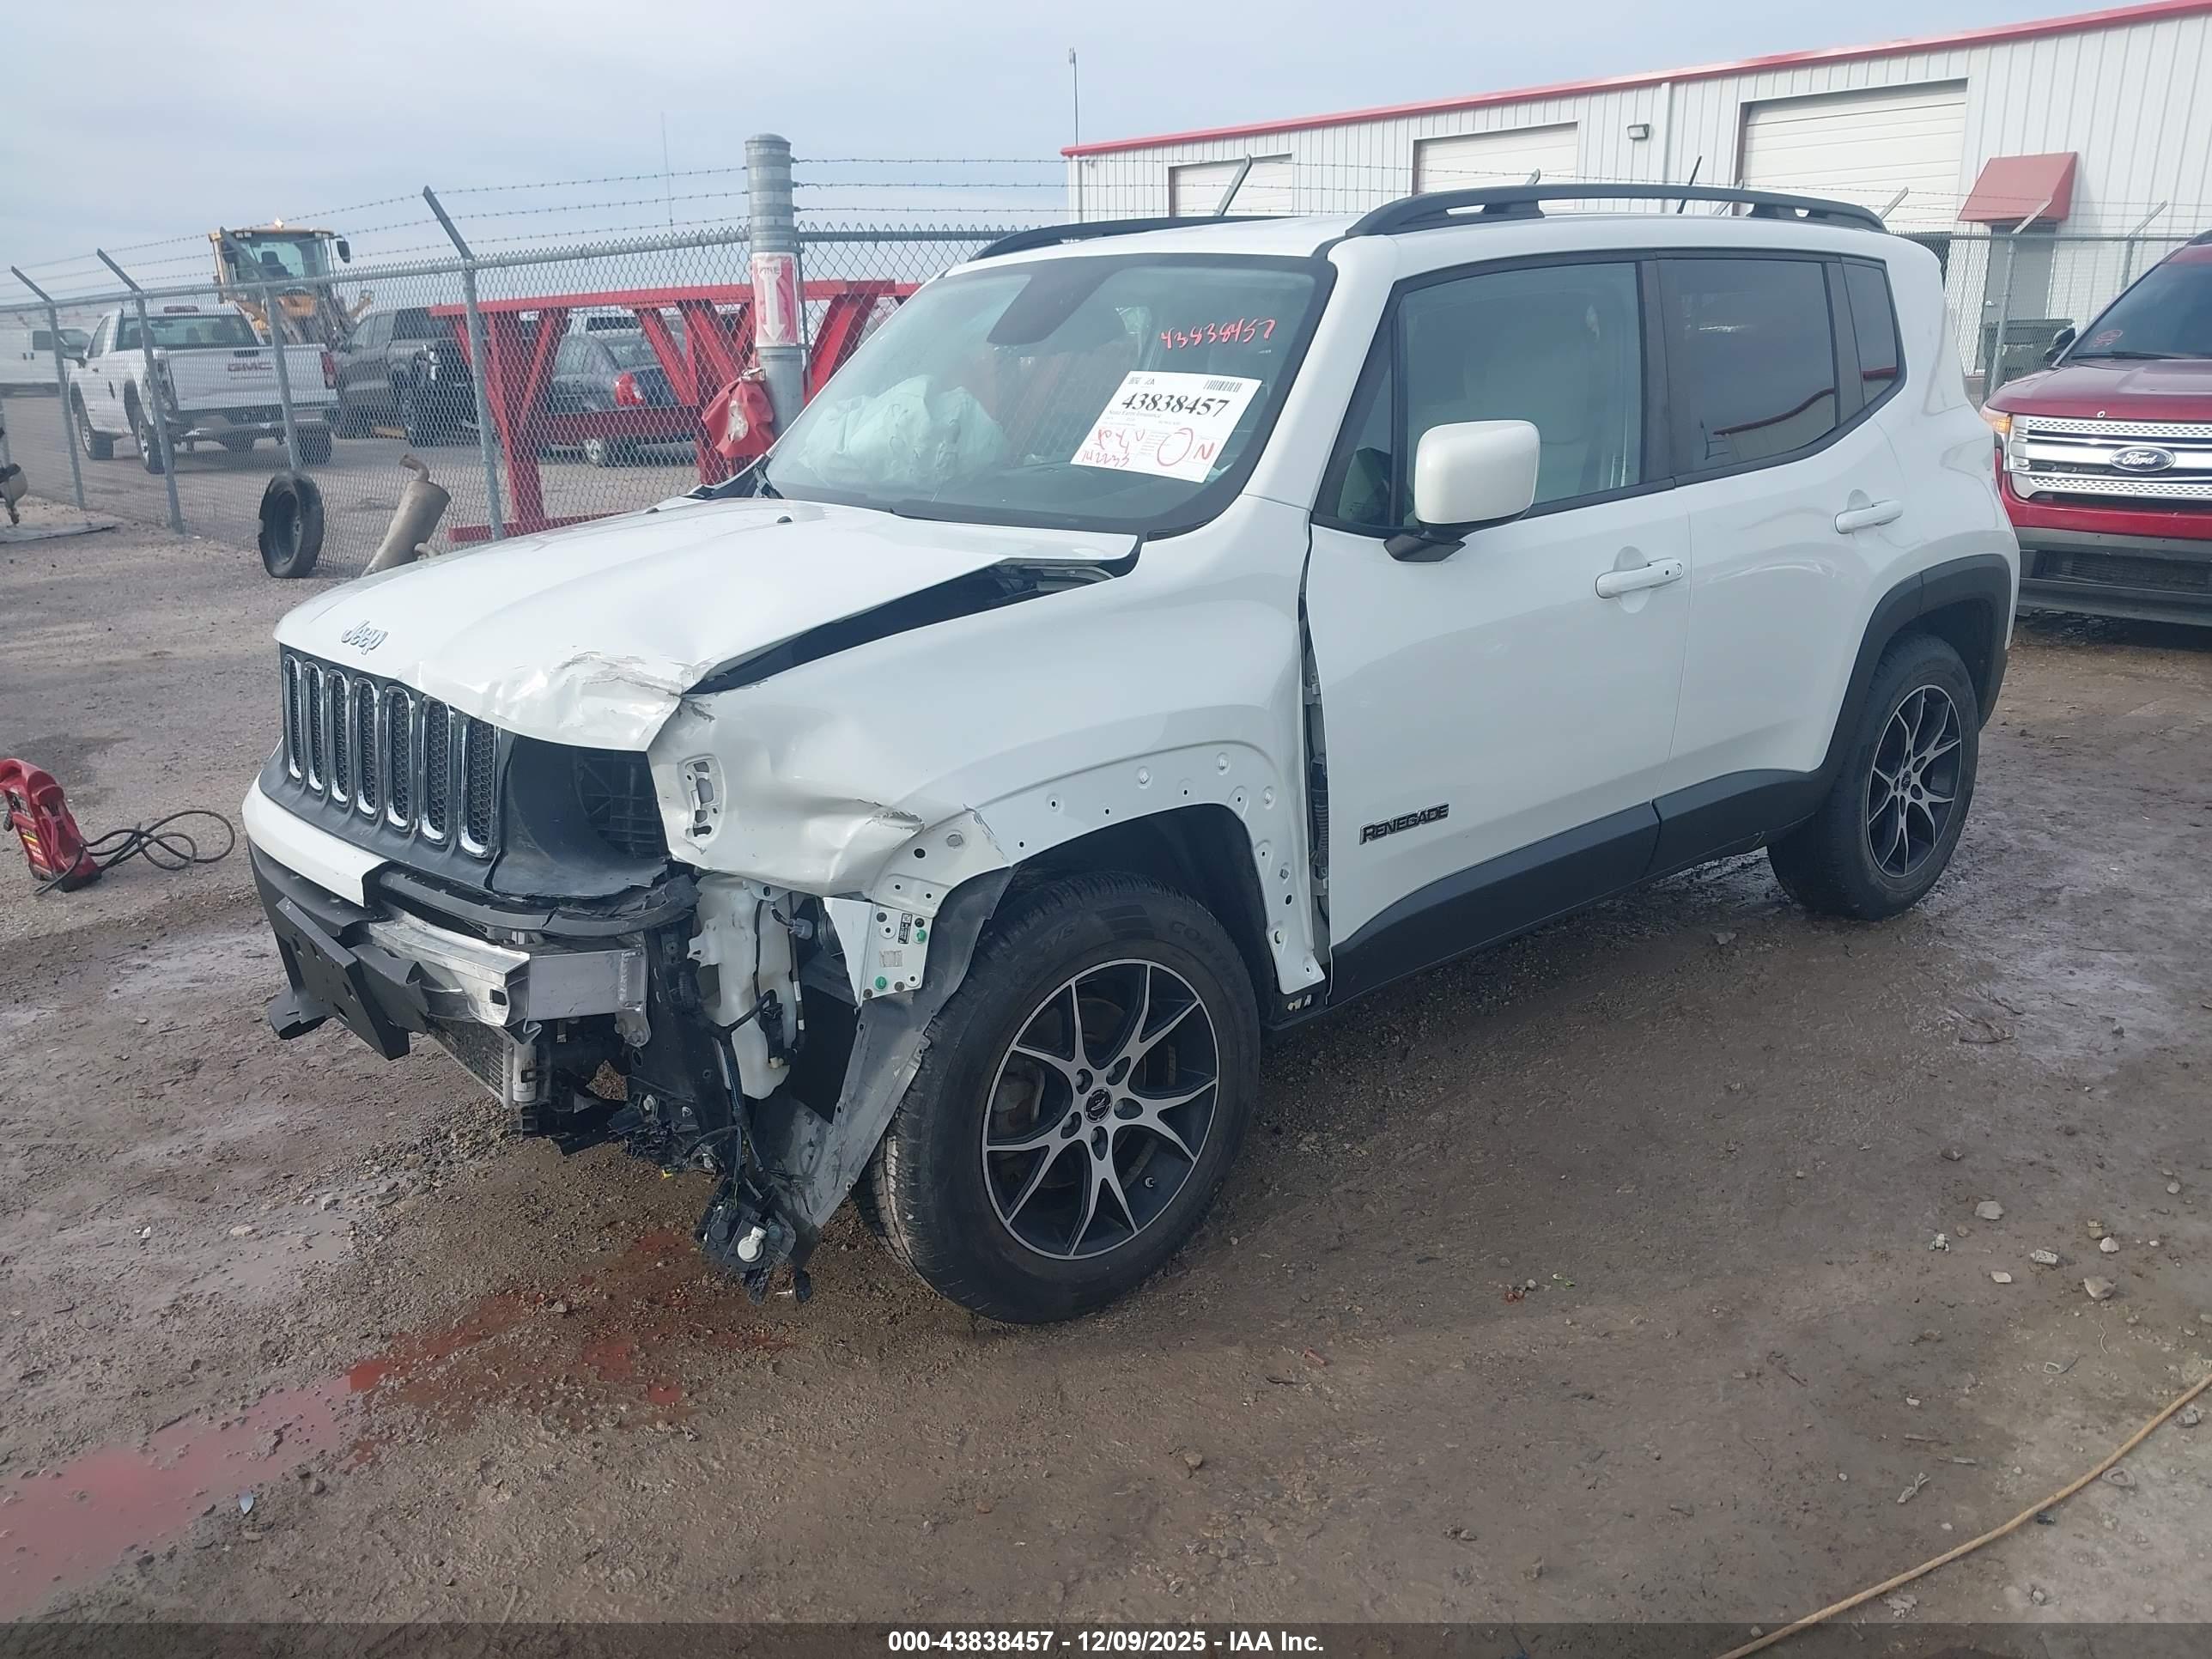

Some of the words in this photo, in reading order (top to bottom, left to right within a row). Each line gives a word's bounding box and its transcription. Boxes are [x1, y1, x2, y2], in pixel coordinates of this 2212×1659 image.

[1160, 318, 1276, 349] 43838457
[228, 362, 273, 372] GMC
[1121, 392, 1231, 417] 43838457
[2122, 451, 2159, 465] Ford
[341, 618, 388, 655] Jeep
[1359, 802, 1449, 846] RENEGADE
